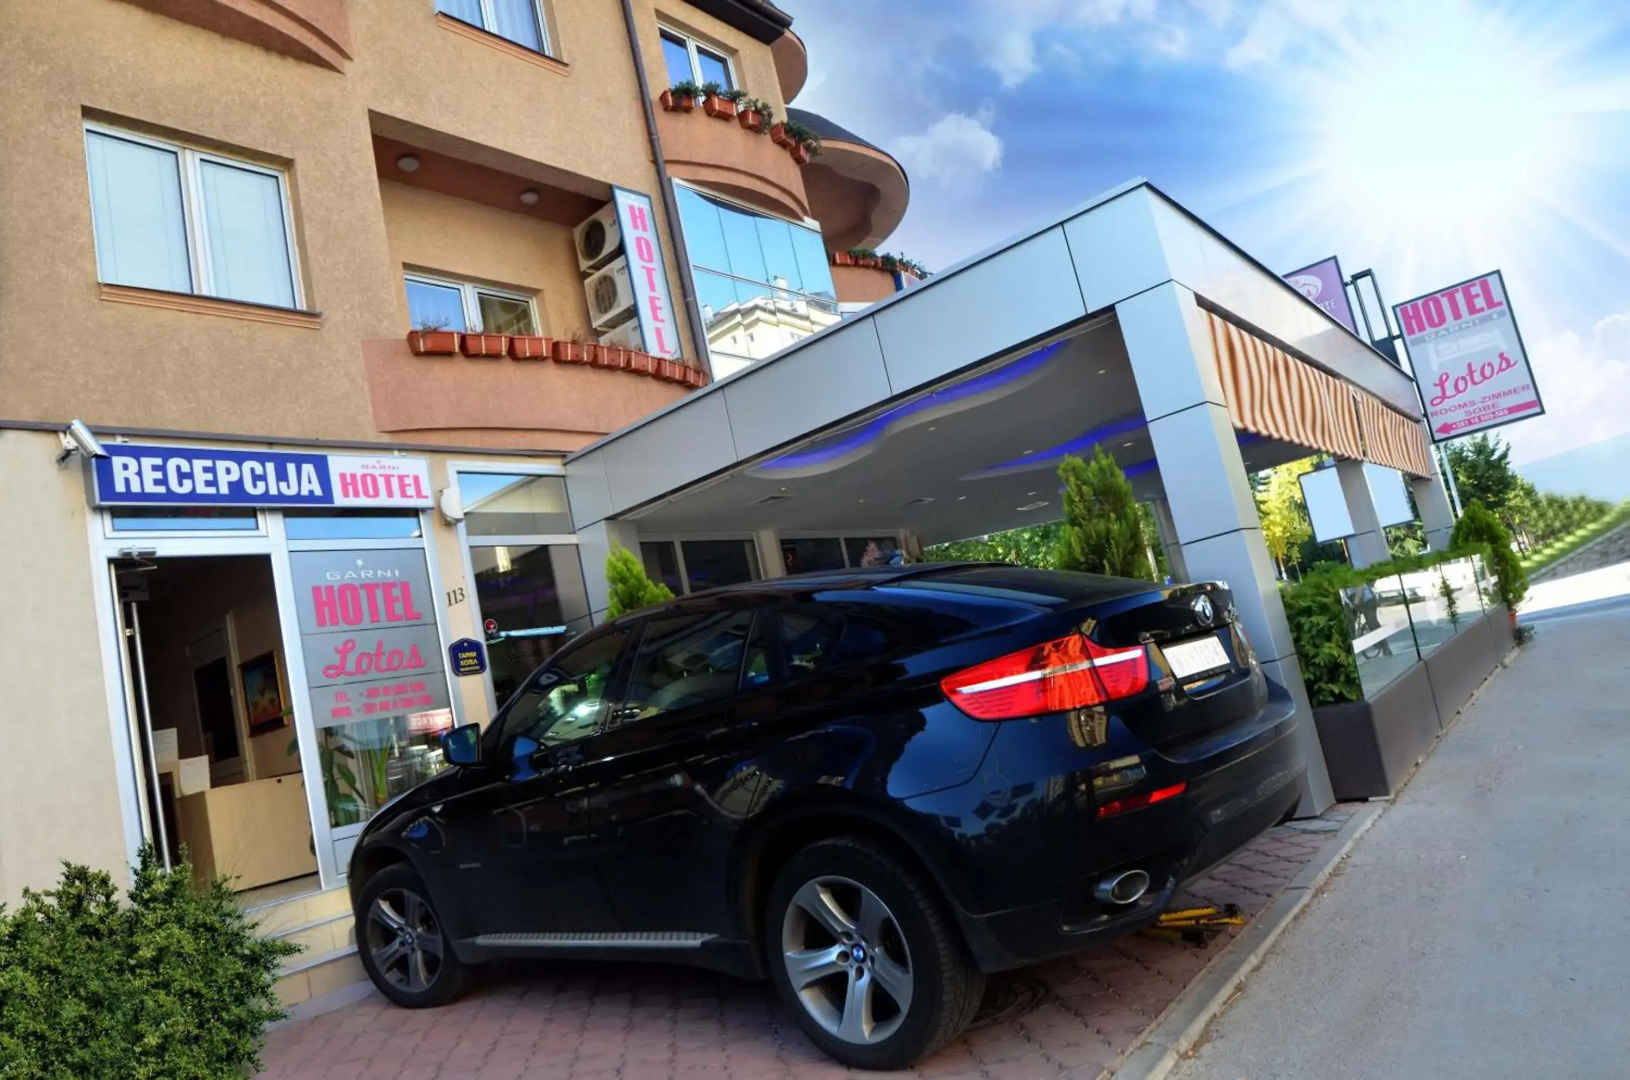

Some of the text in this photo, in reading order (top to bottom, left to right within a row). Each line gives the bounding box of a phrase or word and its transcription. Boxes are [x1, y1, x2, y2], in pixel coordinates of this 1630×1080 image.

[629, 204, 673, 355] HOTEL
[1399, 278, 1504, 336] HOTEL
[1430, 350, 1518, 407] Lotos
[1464, 402, 1500, 417] SOBE
[111, 456, 430, 500] RECEPCIJA HOTEL
[361, 463, 400, 471] GARNI
[326, 568, 400, 581] GARNI
[312, 581, 423, 628] HOTEL
[445, 587, 466, 607] 113
[322, 638, 427, 679] Lotos
